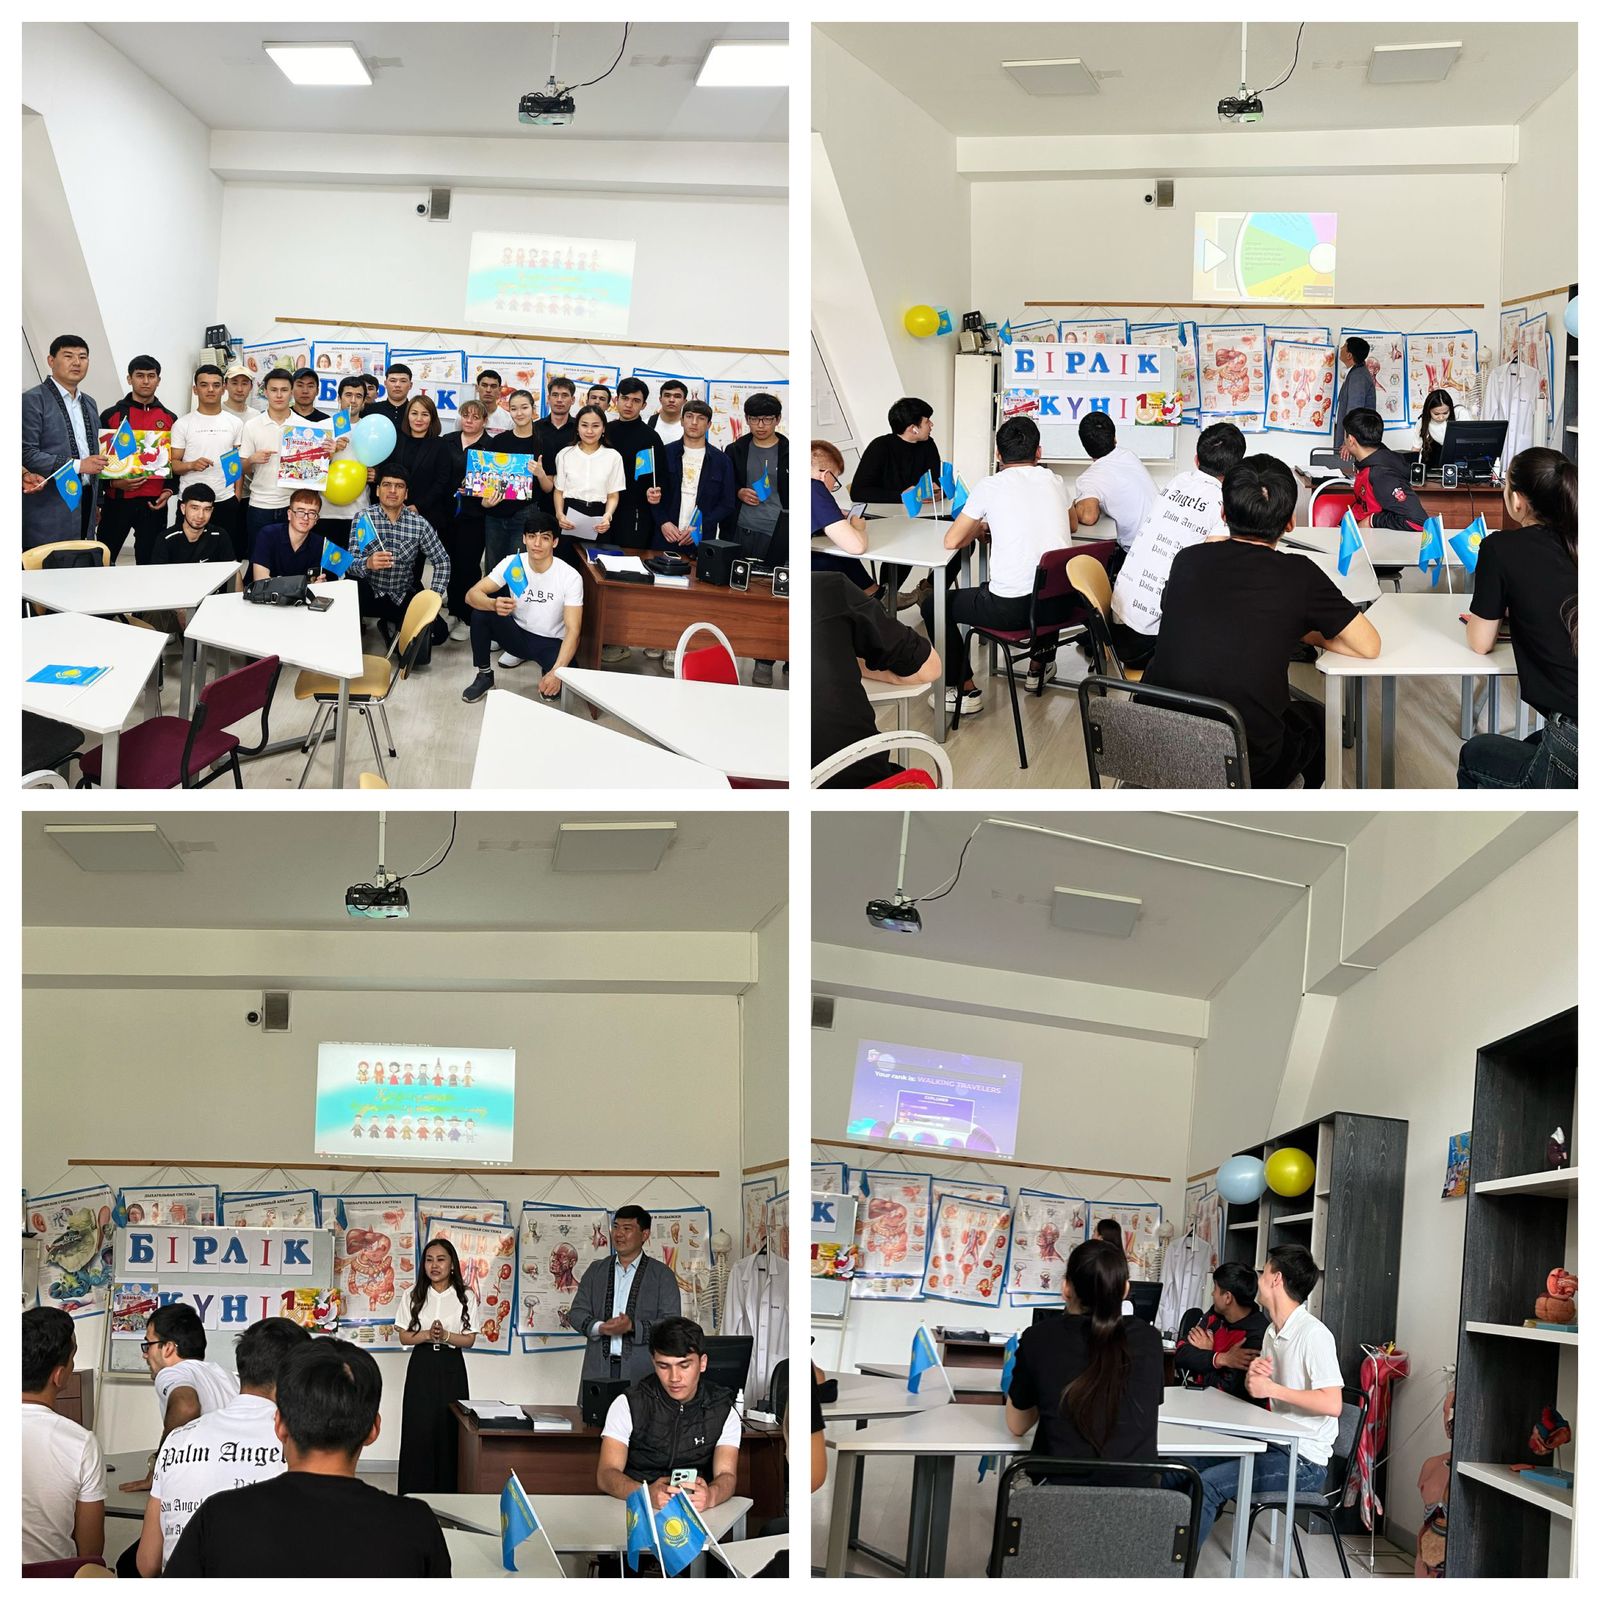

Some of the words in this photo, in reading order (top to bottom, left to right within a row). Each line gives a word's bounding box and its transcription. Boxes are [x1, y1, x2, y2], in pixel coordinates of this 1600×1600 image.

[1014, 349, 1160, 375] БІРЛІК
[522, 589, 554, 600] ABR
[917, 1076, 955, 1087] WALKING
[955, 1082, 1001, 1094] TRAVELERS
[128, 1233, 312, 1266] БІРЛІК
[281, 1290, 296, 1311] 1
[161, 1443, 210, 1473] Palm
[218, 1441, 288, 1467] Ange
[174, 1498, 204, 1513] Ange
